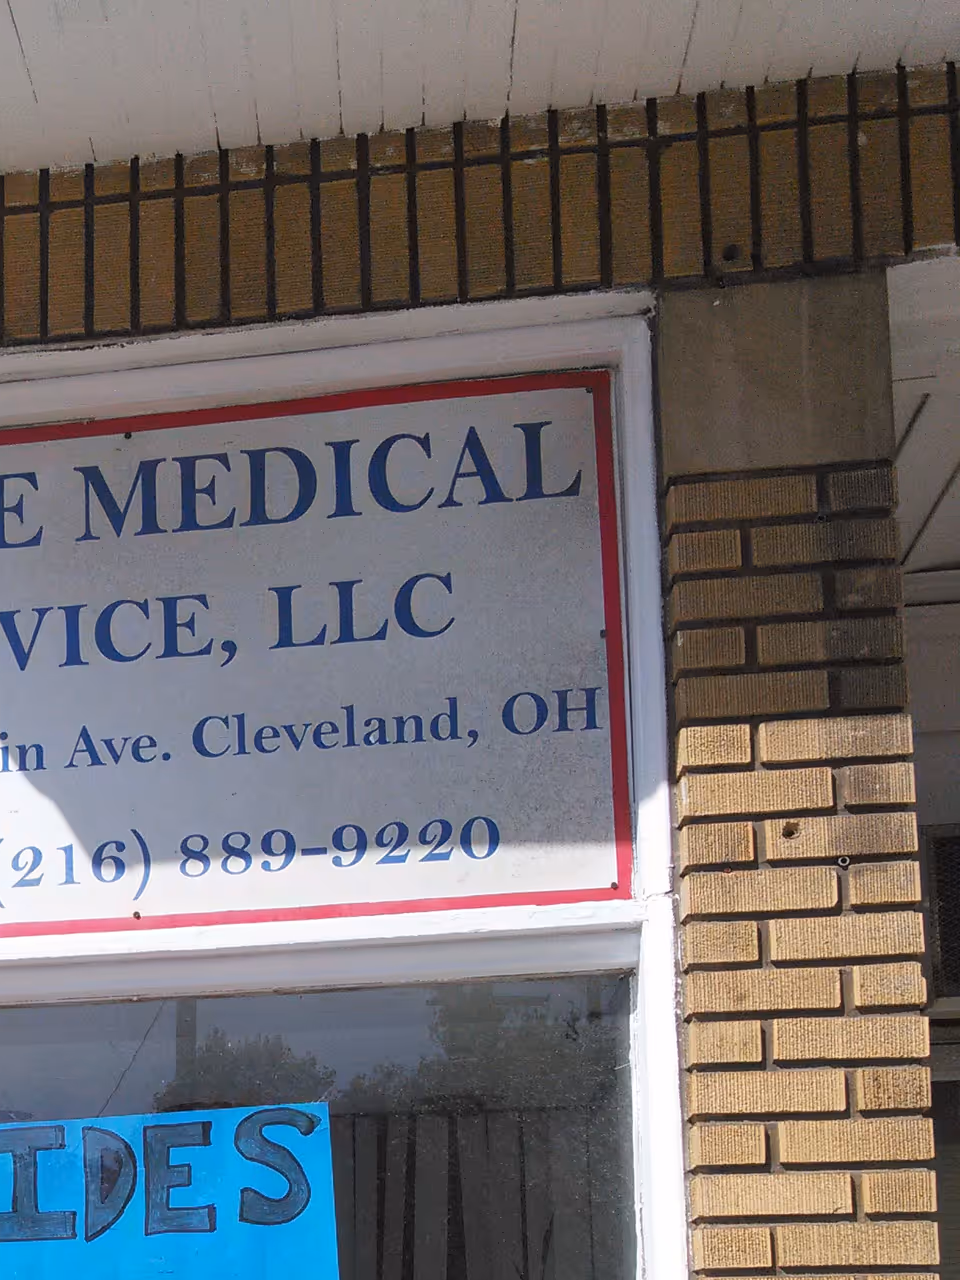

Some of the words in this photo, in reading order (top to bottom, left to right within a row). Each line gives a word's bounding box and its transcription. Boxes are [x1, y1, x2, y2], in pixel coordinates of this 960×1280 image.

[73, 420, 583, 542] MEDICAL
[268, 572, 455, 650] LLC
[64, 725, 172, 768] Ave.
[192, 696, 480, 761] Cleveland,
[501, 686, 603, 737] OH
[178, 815, 501, 880] 889-9220
